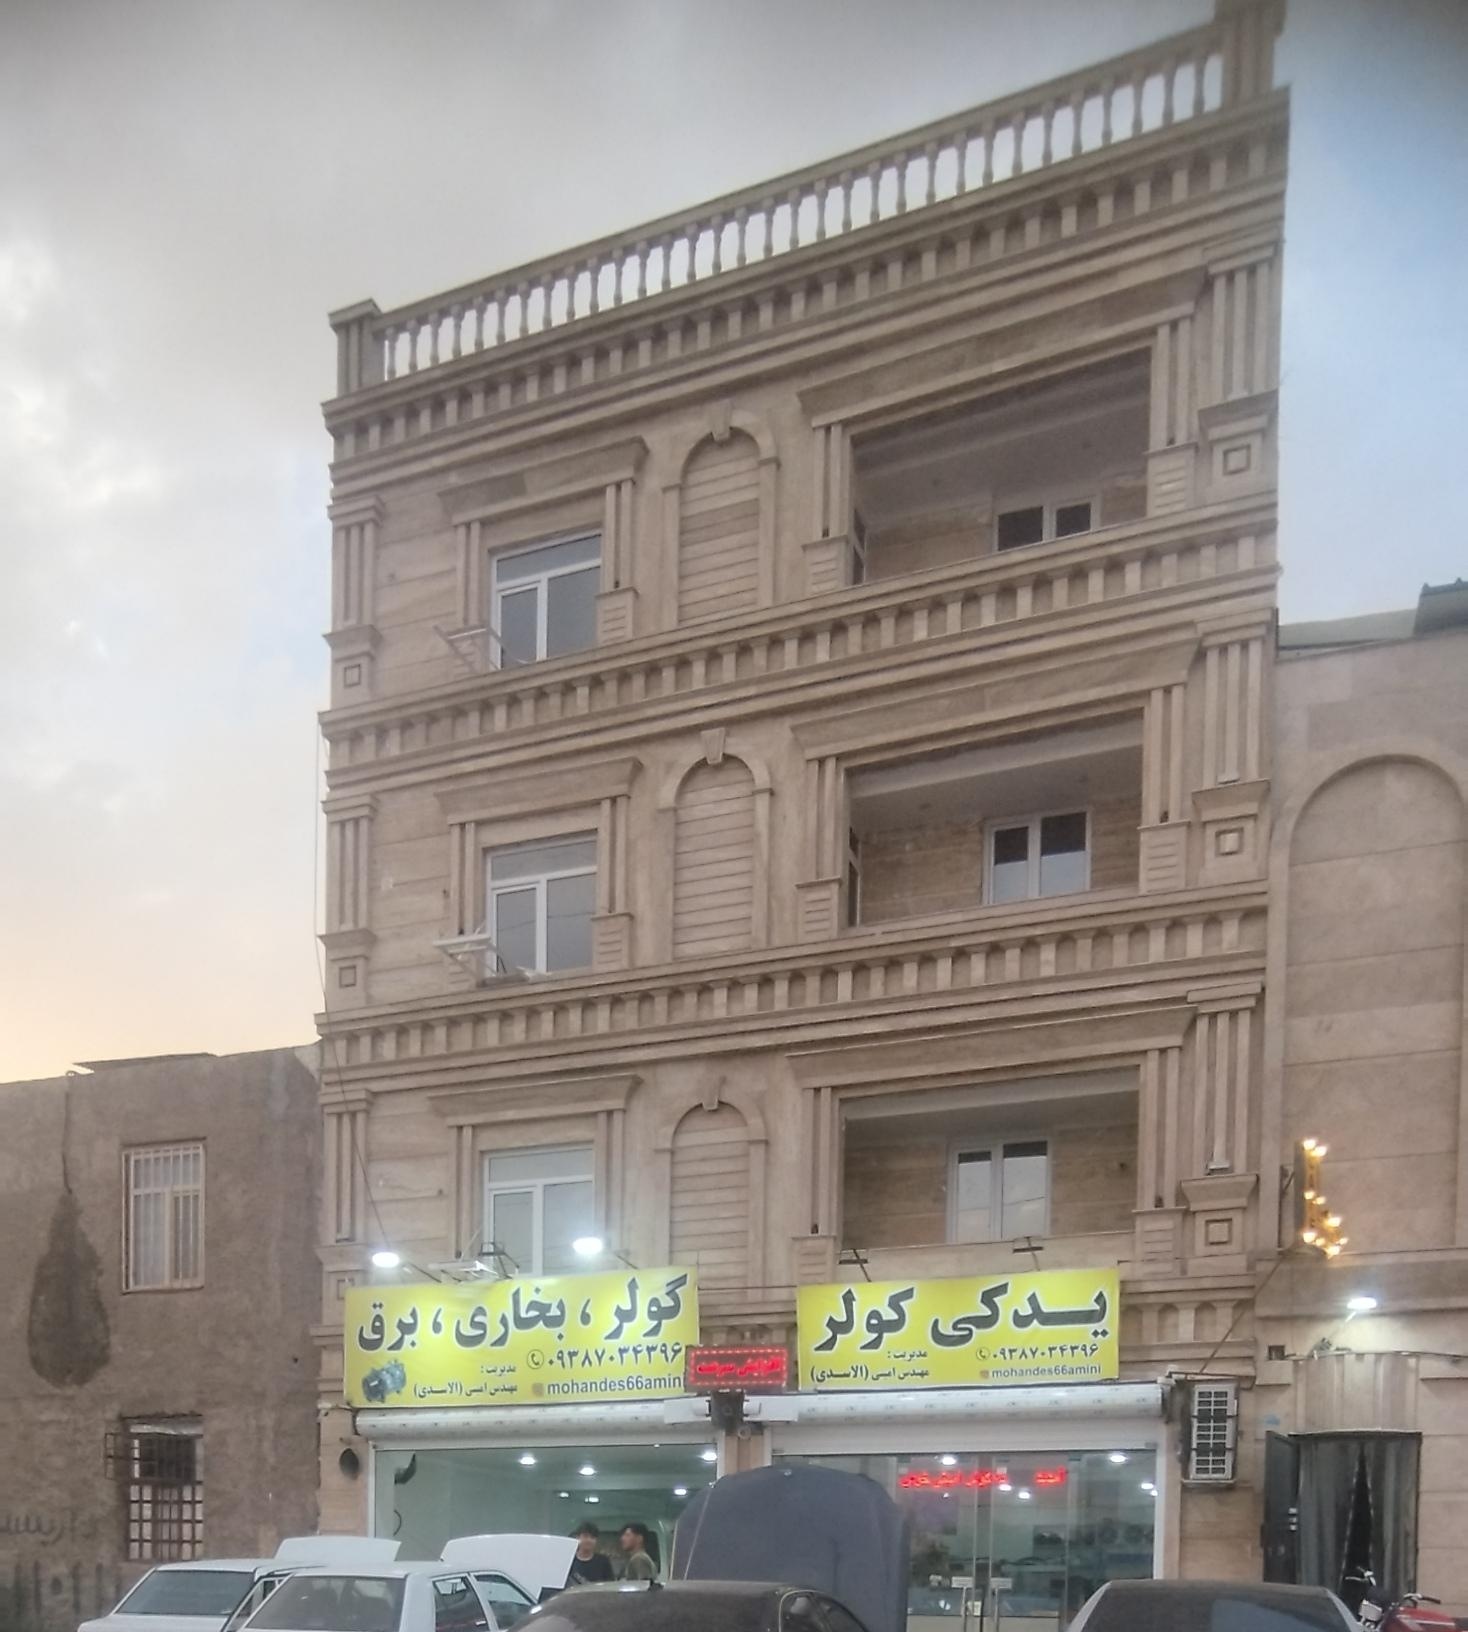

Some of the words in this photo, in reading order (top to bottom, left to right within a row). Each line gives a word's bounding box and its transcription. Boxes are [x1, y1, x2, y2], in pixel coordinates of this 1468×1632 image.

[358, 1301, 419, 1351] برق
[455, 1286, 566, 1348] بخاری
[813, 1286, 914, 1352] کولر
[930, 1282, 1109, 1347] یدکی
[548, 1342, 683, 1369] ۰۹۳۸۷۰۳۴۳۹۶
[993, 1343, 1099, 1360] ۰۹۳۸۷۰۳۴۳۹۶
[547, 1374, 686, 1395] mohandes66amin
[992, 1365, 1101, 1379] mohandes66amini
